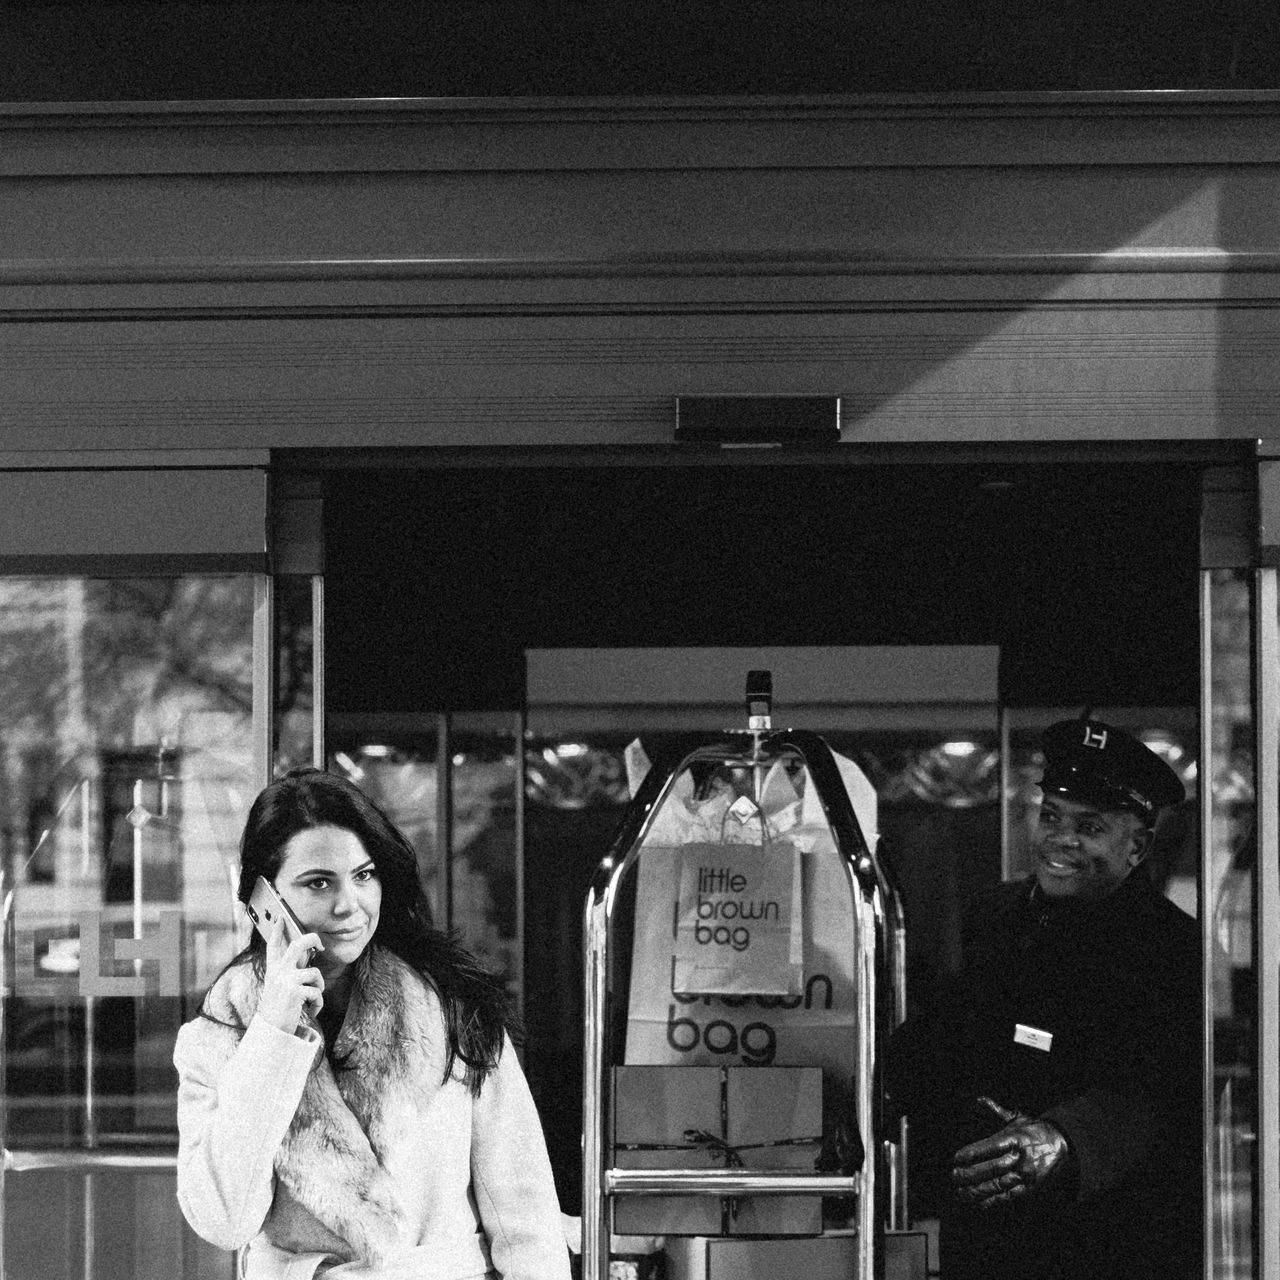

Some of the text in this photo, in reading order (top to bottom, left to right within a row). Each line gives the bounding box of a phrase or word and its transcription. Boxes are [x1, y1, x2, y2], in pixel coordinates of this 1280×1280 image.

[698, 867, 747, 893] little
[697, 894, 779, 920] brown
[694, 919, 750, 951] bag
[667, 1004, 777, 1068] bag
